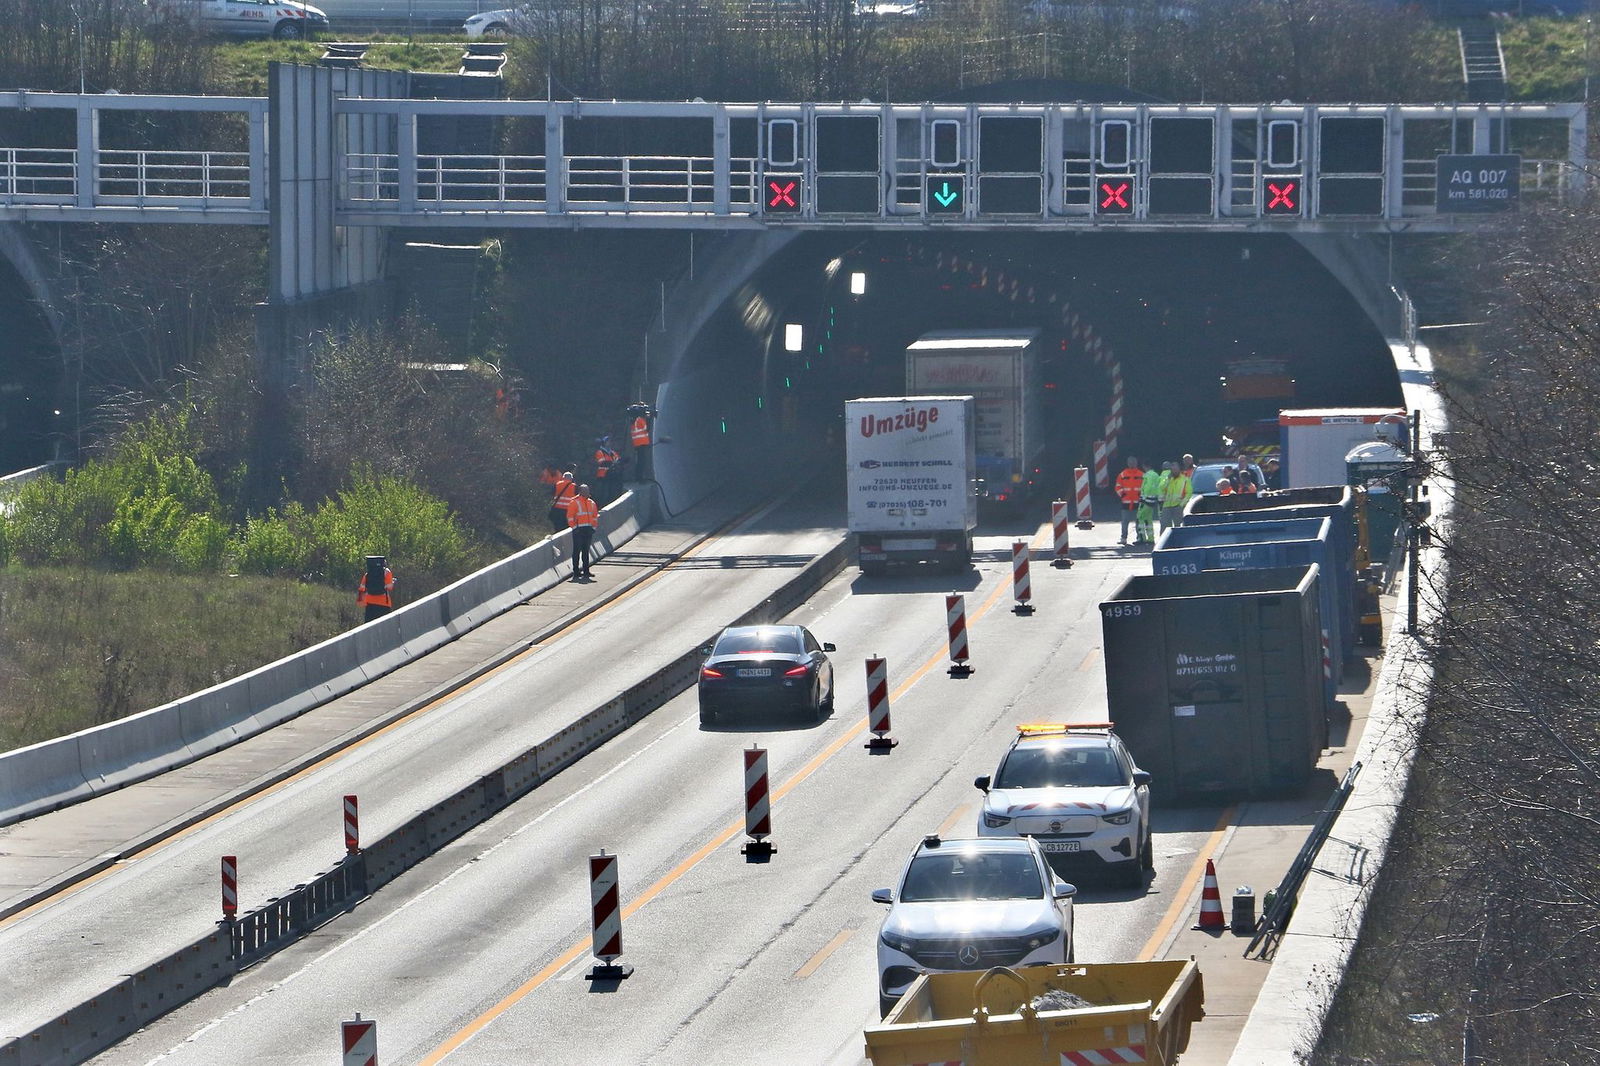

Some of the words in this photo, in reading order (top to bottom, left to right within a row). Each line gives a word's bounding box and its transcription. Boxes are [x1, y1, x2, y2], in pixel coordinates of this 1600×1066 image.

[1450, 170, 1472, 184] AQ
[1479, 169, 1507, 184] 007
[1448, 189, 1465, 199] km
[861, 406, 939, 438] Umzüge
[1219, 549, 1252, 561] Kämpf
[1162, 563, 1197, 576] 5033
[1105, 604, 1142, 618] 4959
